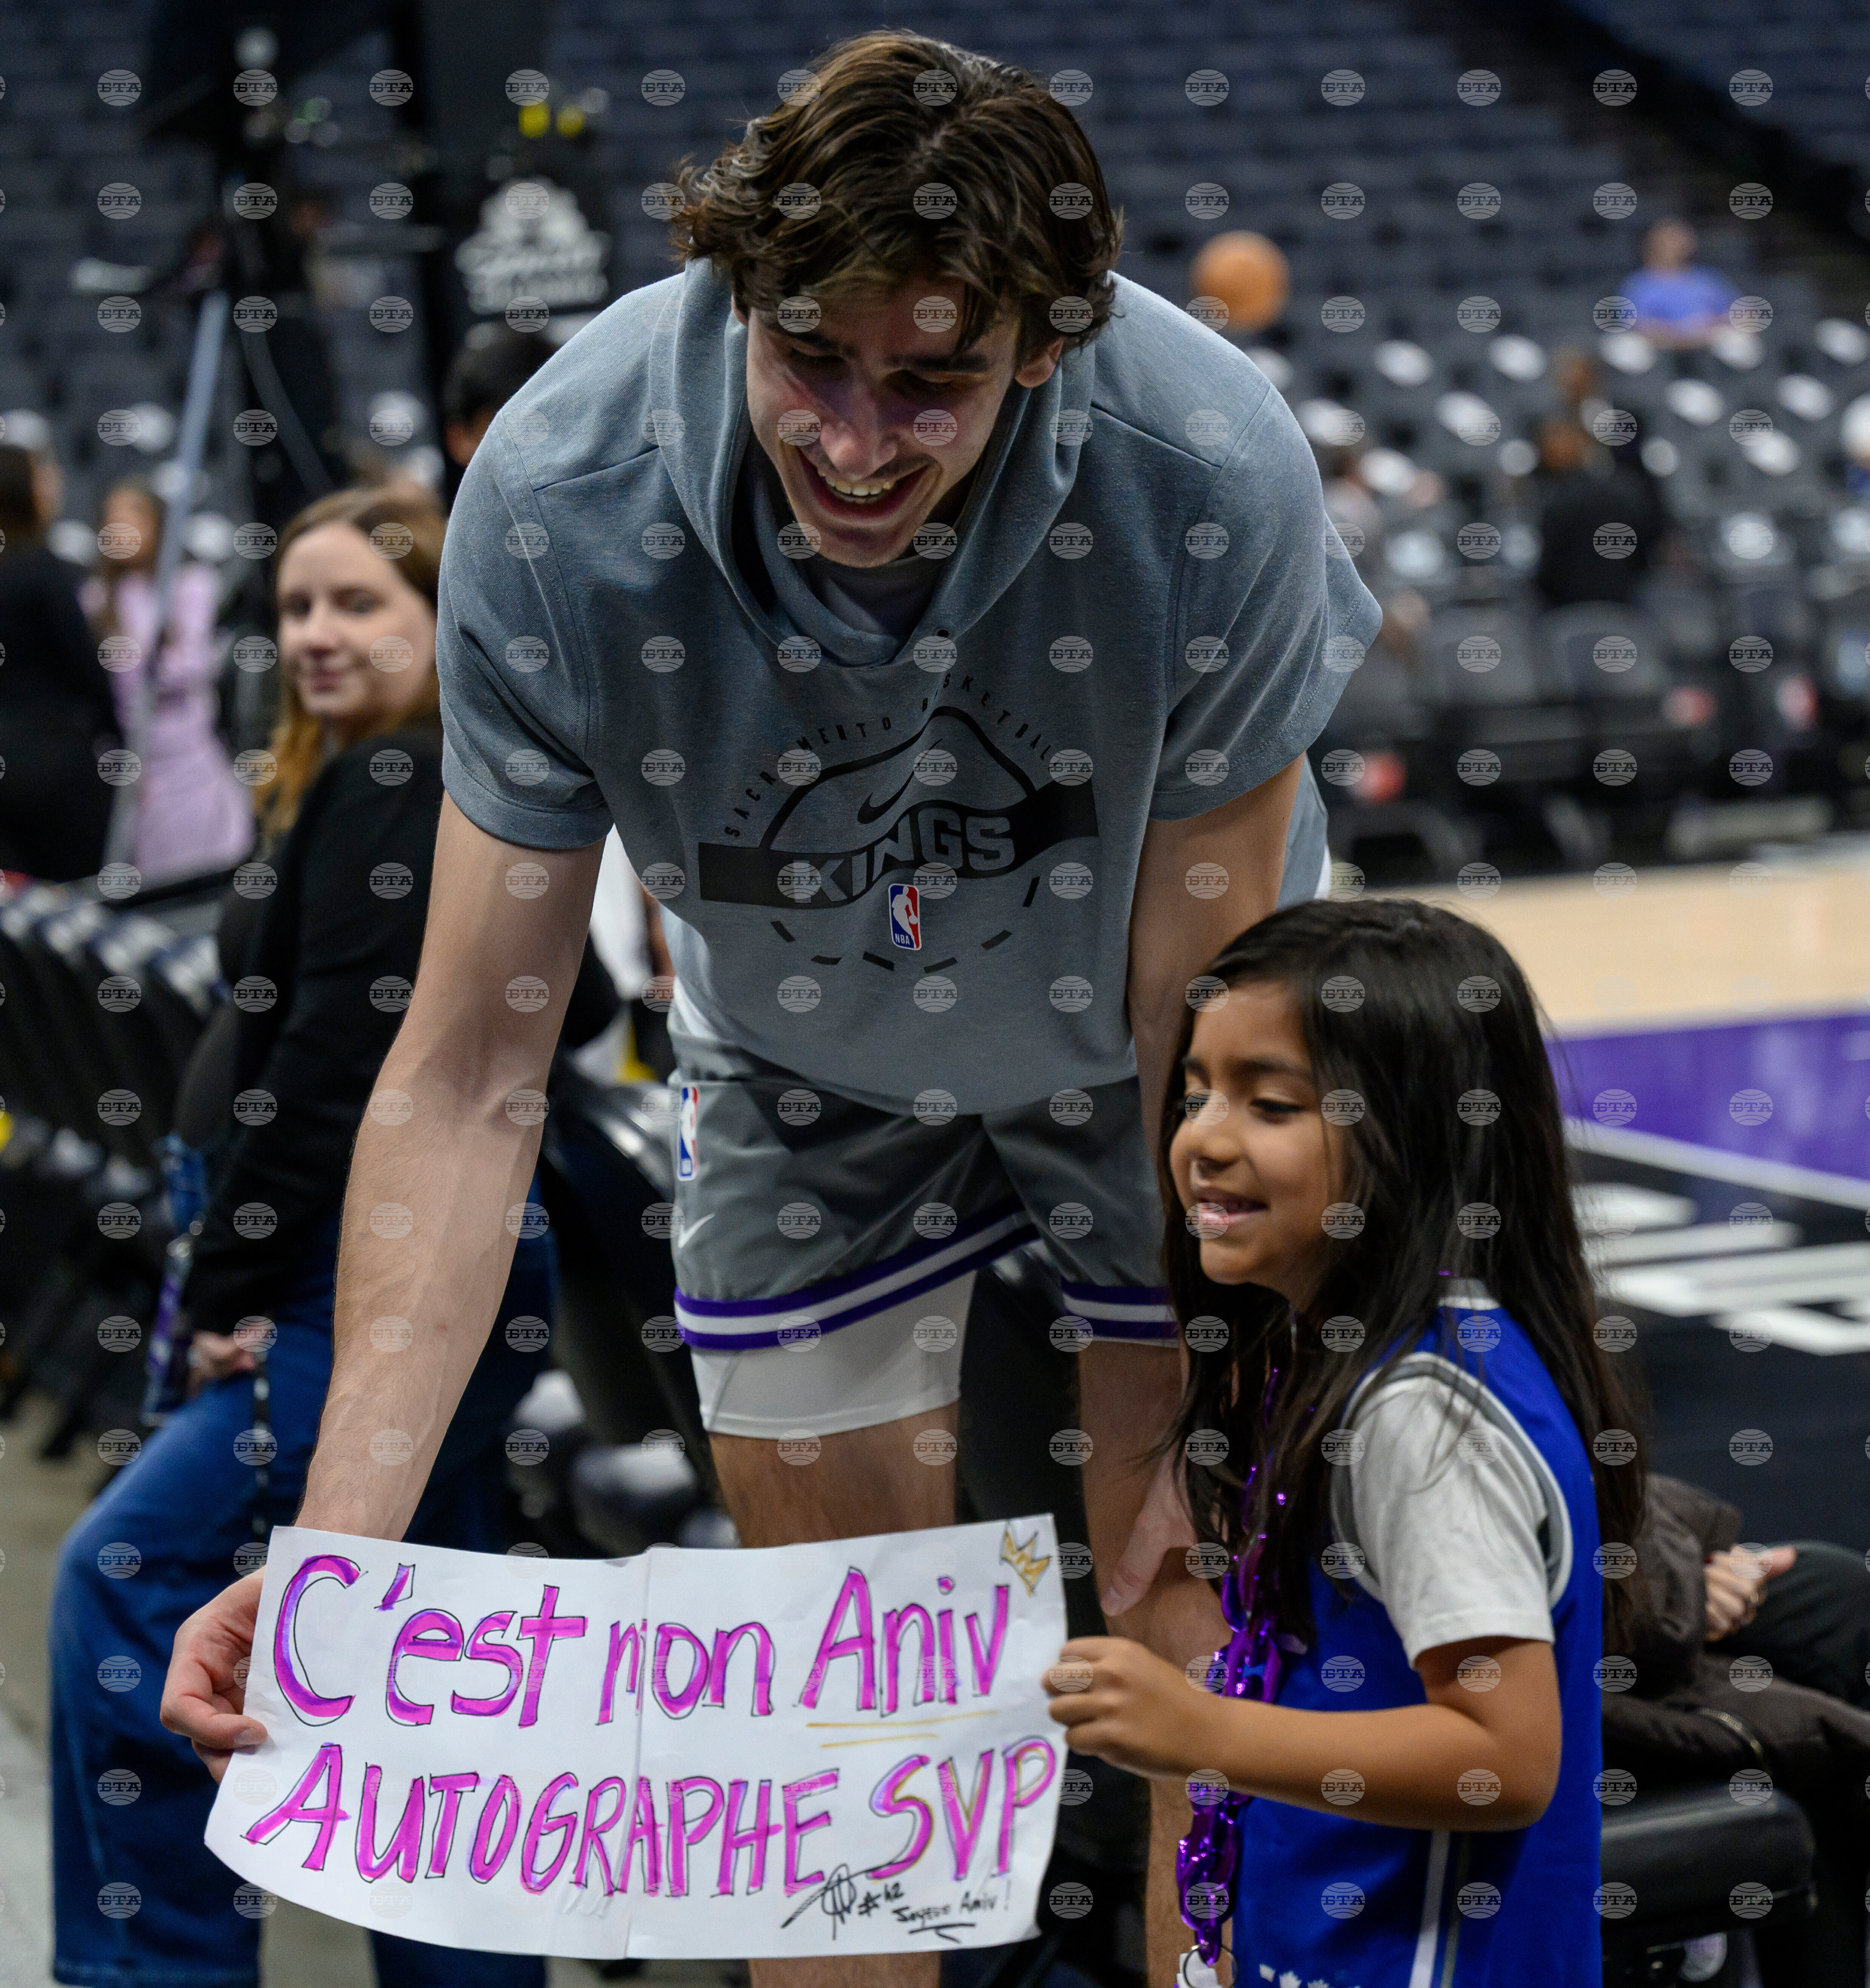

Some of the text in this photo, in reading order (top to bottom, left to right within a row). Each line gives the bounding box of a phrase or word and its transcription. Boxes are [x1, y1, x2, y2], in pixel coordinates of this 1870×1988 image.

[922, 673, 1061, 771] BSKETBALL
[794, 807, 1015, 904] KINGS
[895, 933, 910, 945] NBA
[273, 1554, 1010, 1729] C'est mon Aniv
[240, 1736, 1056, 1898] AUTOGRAPHE SVP
